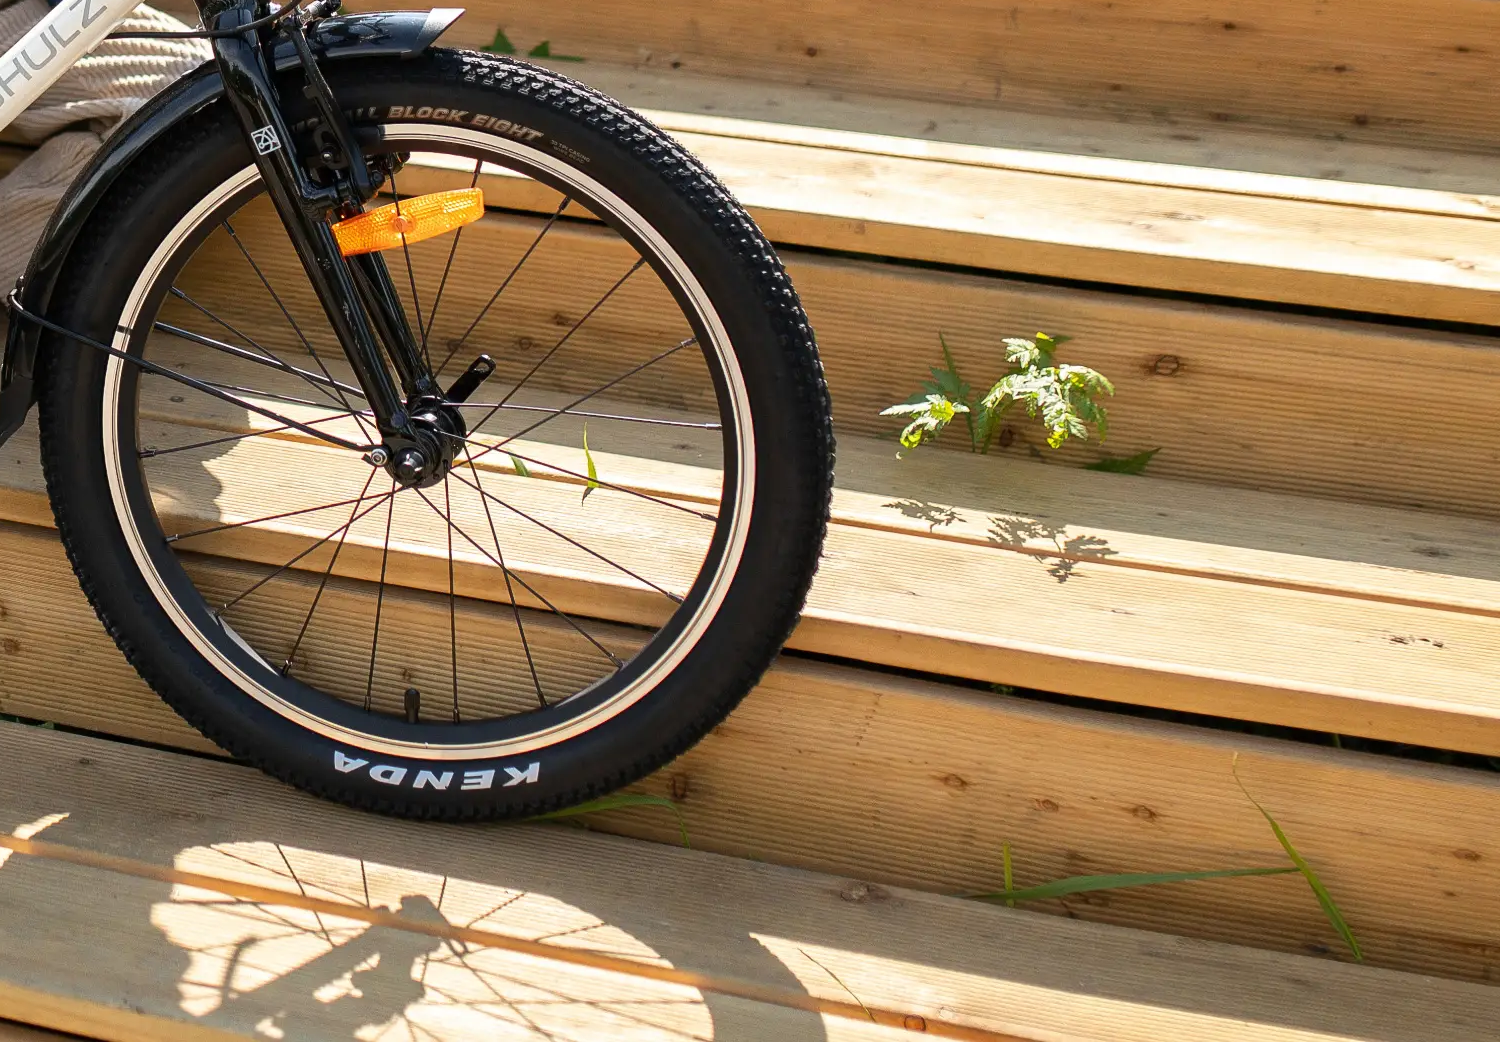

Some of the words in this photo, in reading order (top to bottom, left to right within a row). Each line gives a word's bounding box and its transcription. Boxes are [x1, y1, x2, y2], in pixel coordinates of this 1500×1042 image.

[387, 106, 469, 124] BLOCK
[471, 114, 545, 142] EIGHT
[334, 750, 540, 790] KENDA
